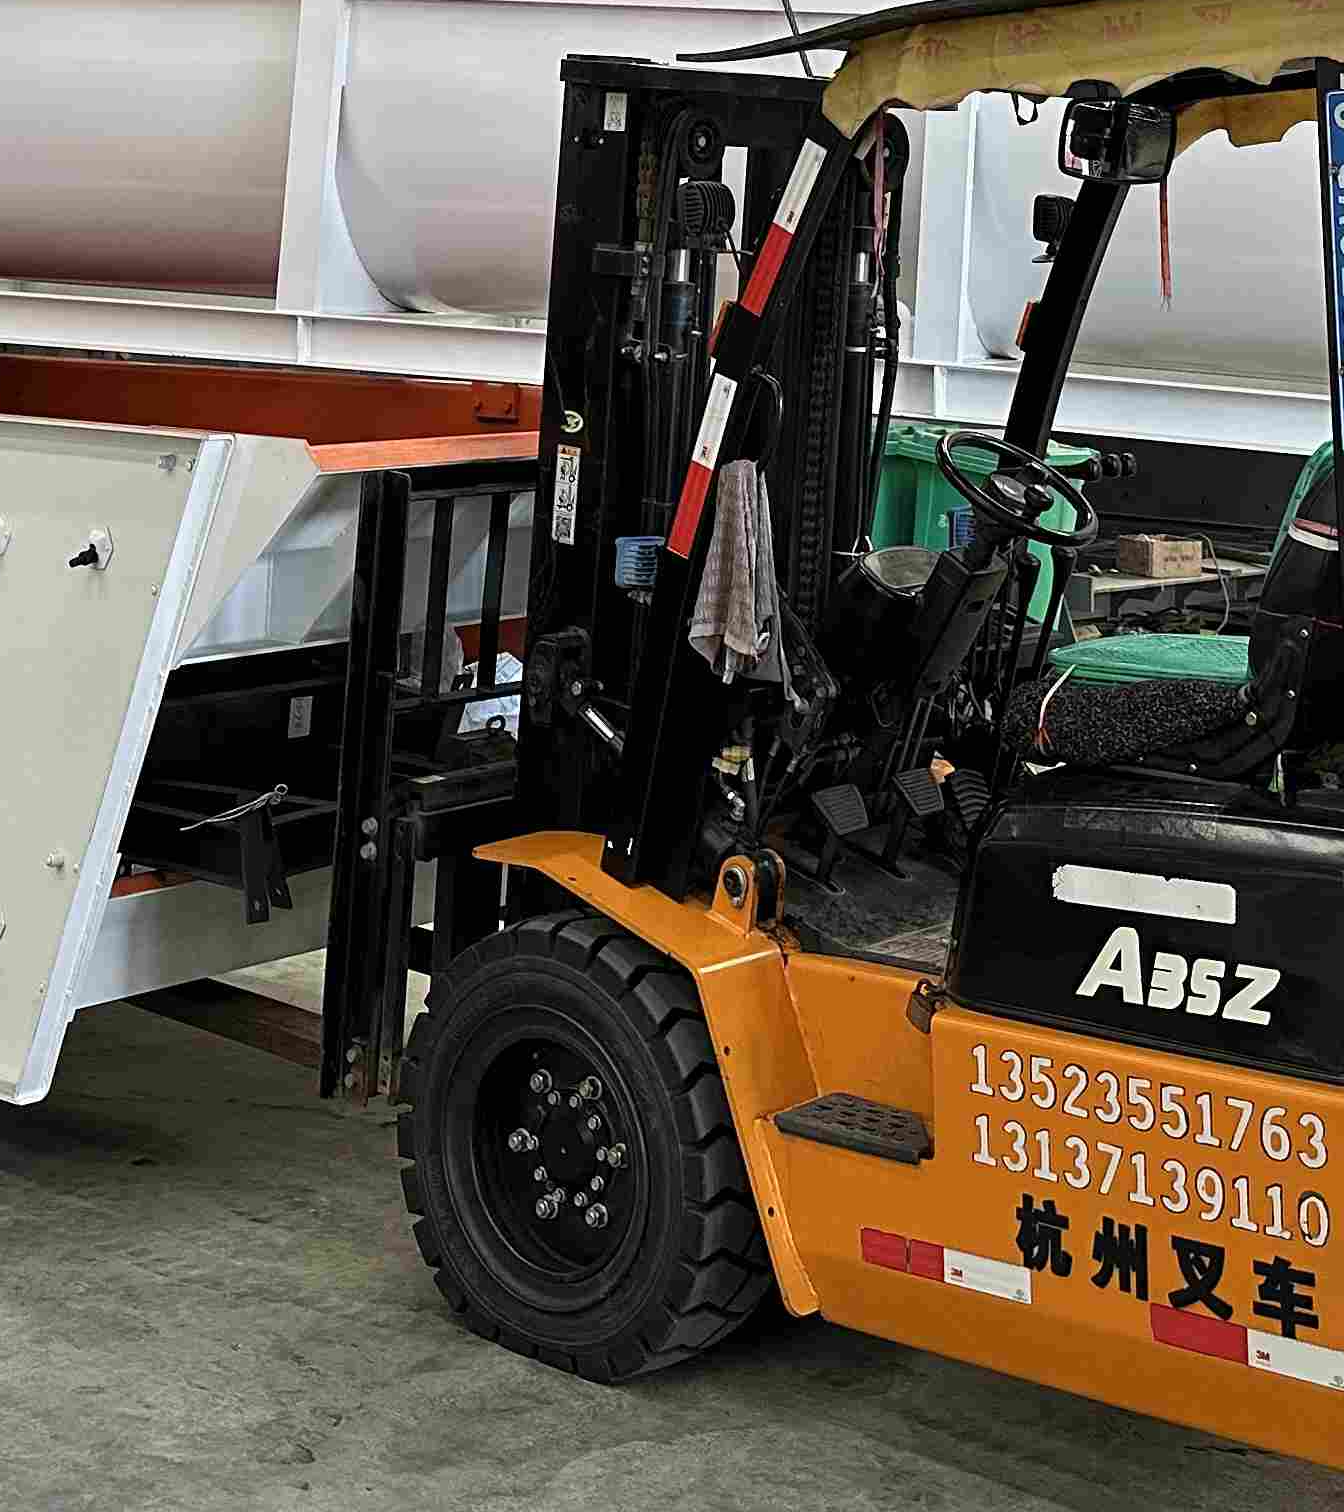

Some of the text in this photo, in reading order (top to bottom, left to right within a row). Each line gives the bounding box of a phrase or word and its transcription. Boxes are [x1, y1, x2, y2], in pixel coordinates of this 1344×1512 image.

[970, 1044, 1328, 1169] 13523551763
[972, 1114, 1329, 1247] 13137139110
[1015, 1192, 1319, 1340] 杭州叉车
[1256, 1349, 1271, 1362] 3M
